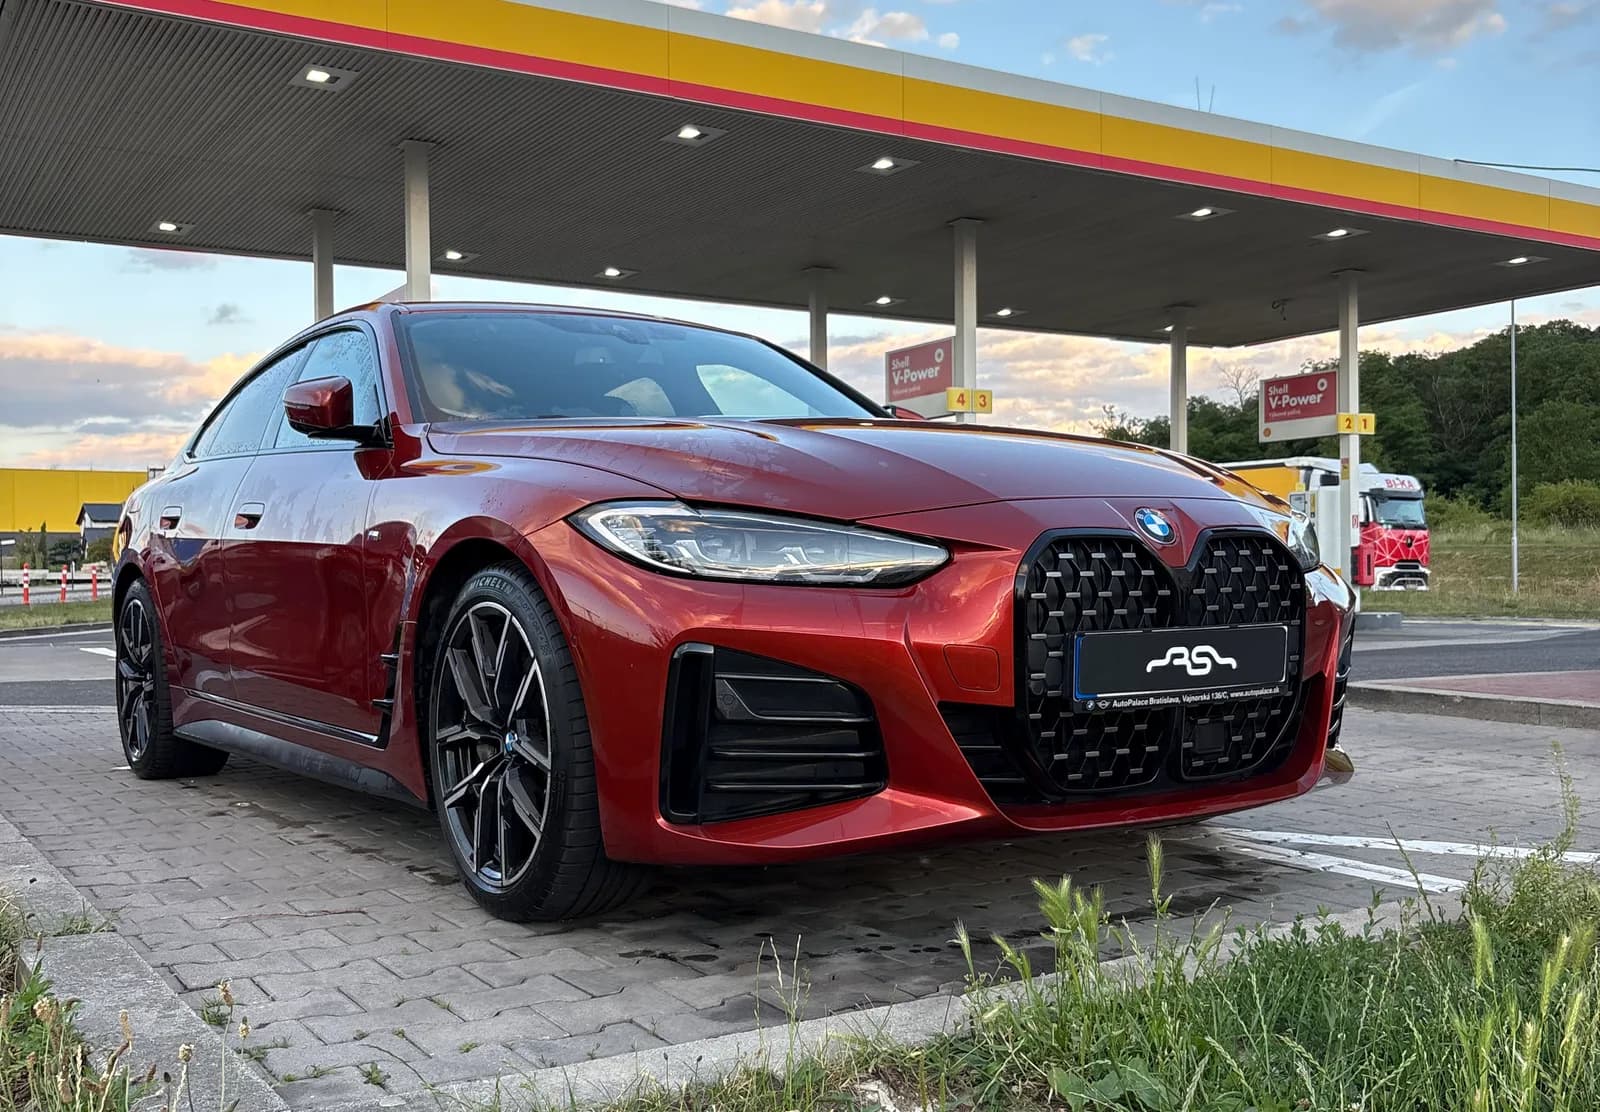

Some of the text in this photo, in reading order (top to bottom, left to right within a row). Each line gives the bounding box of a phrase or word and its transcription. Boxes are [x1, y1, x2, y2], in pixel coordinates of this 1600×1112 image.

[892, 356, 910, 370] Shell
[893, 366, 940, 385] V-Power
[1268, 384, 1289, 396] Shell
[957, 393, 987, 408] 4 3
[1269, 393, 1323, 409] V-Power
[1345, 417, 1368, 430] 2 1
[469, 577, 513, 594] MICHELIN
[1112, 698, 1149, 708] AutoPalace
[1149, 696, 1181, 705] Bratislava,
[1230, 686, 1279, 697] www.autopalace.sk
